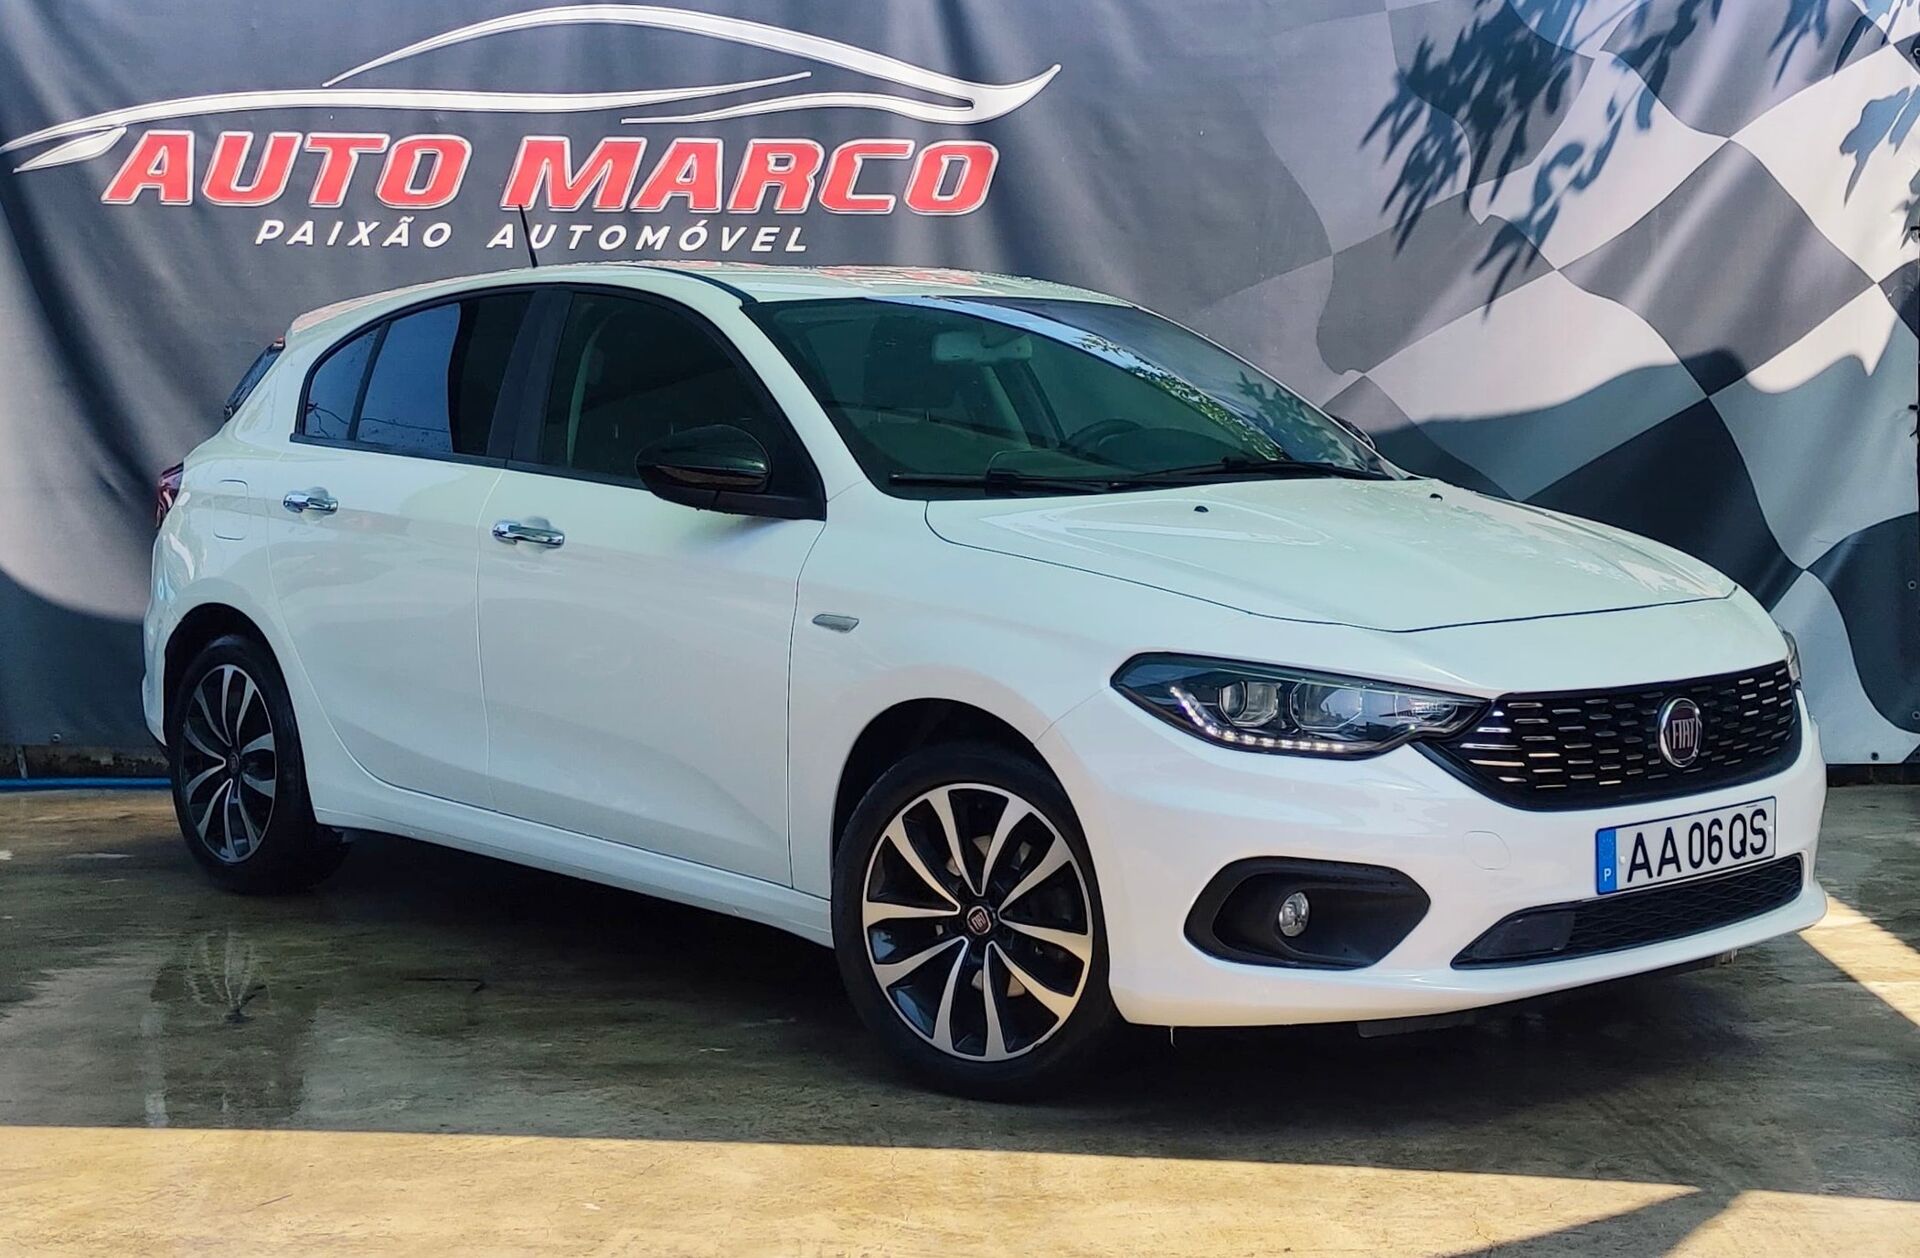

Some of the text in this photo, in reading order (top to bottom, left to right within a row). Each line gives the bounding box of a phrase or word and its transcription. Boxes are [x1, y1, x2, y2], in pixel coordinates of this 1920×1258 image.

[101, 129, 1000, 215] AUTO MARCO
[254, 216, 808, 253] PAIXÃO AUTOMÓVEL
[1672, 718, 1697, 750] FIAT
[1603, 868, 1612, 882] P
